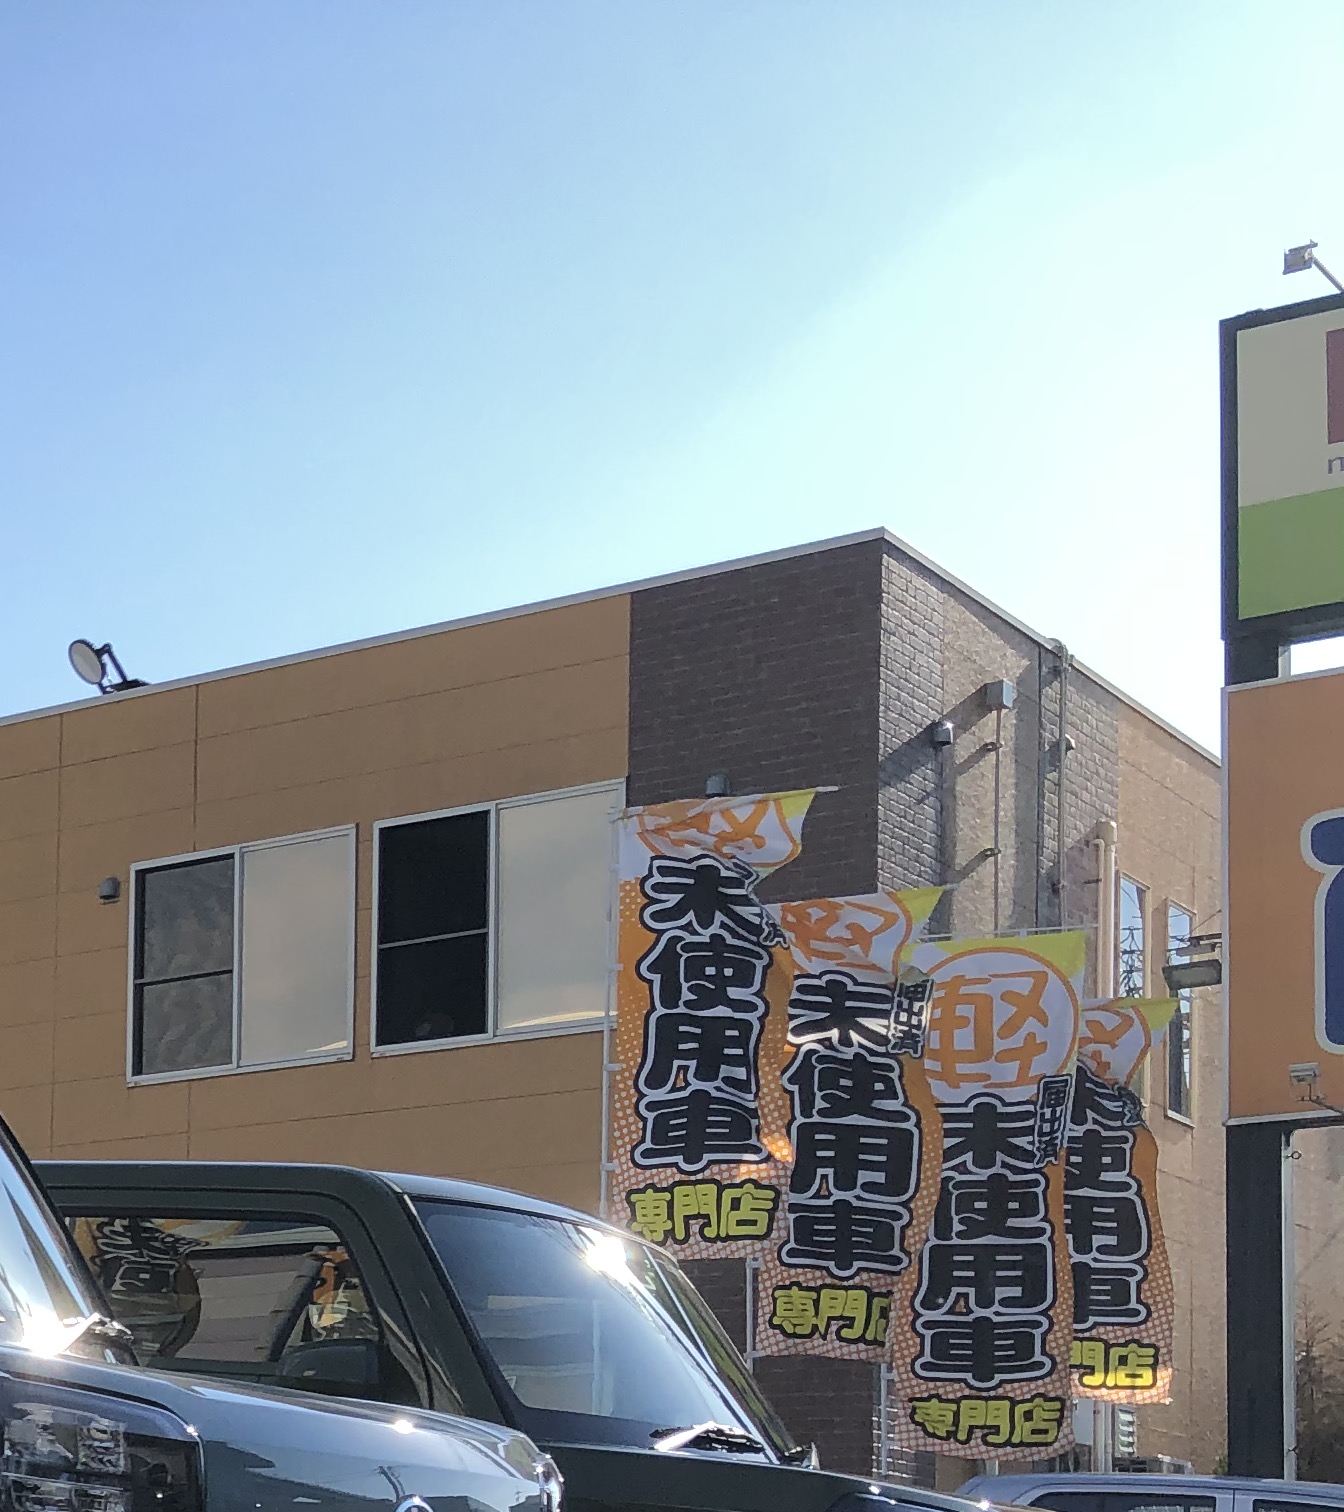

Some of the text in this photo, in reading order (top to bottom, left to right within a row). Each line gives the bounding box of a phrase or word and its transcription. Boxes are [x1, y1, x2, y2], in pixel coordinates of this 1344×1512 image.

[642, 855, 772, 1172] 未使用車
[924, 970, 1049, 1089] 軽
[630, 1182, 776, 1242] 専門店
[780, 973, 920, 1278] 未使用車
[914, 1097, 1056, 1388] 未使用車
[912, 1397, 1062, 1444] 専門店
